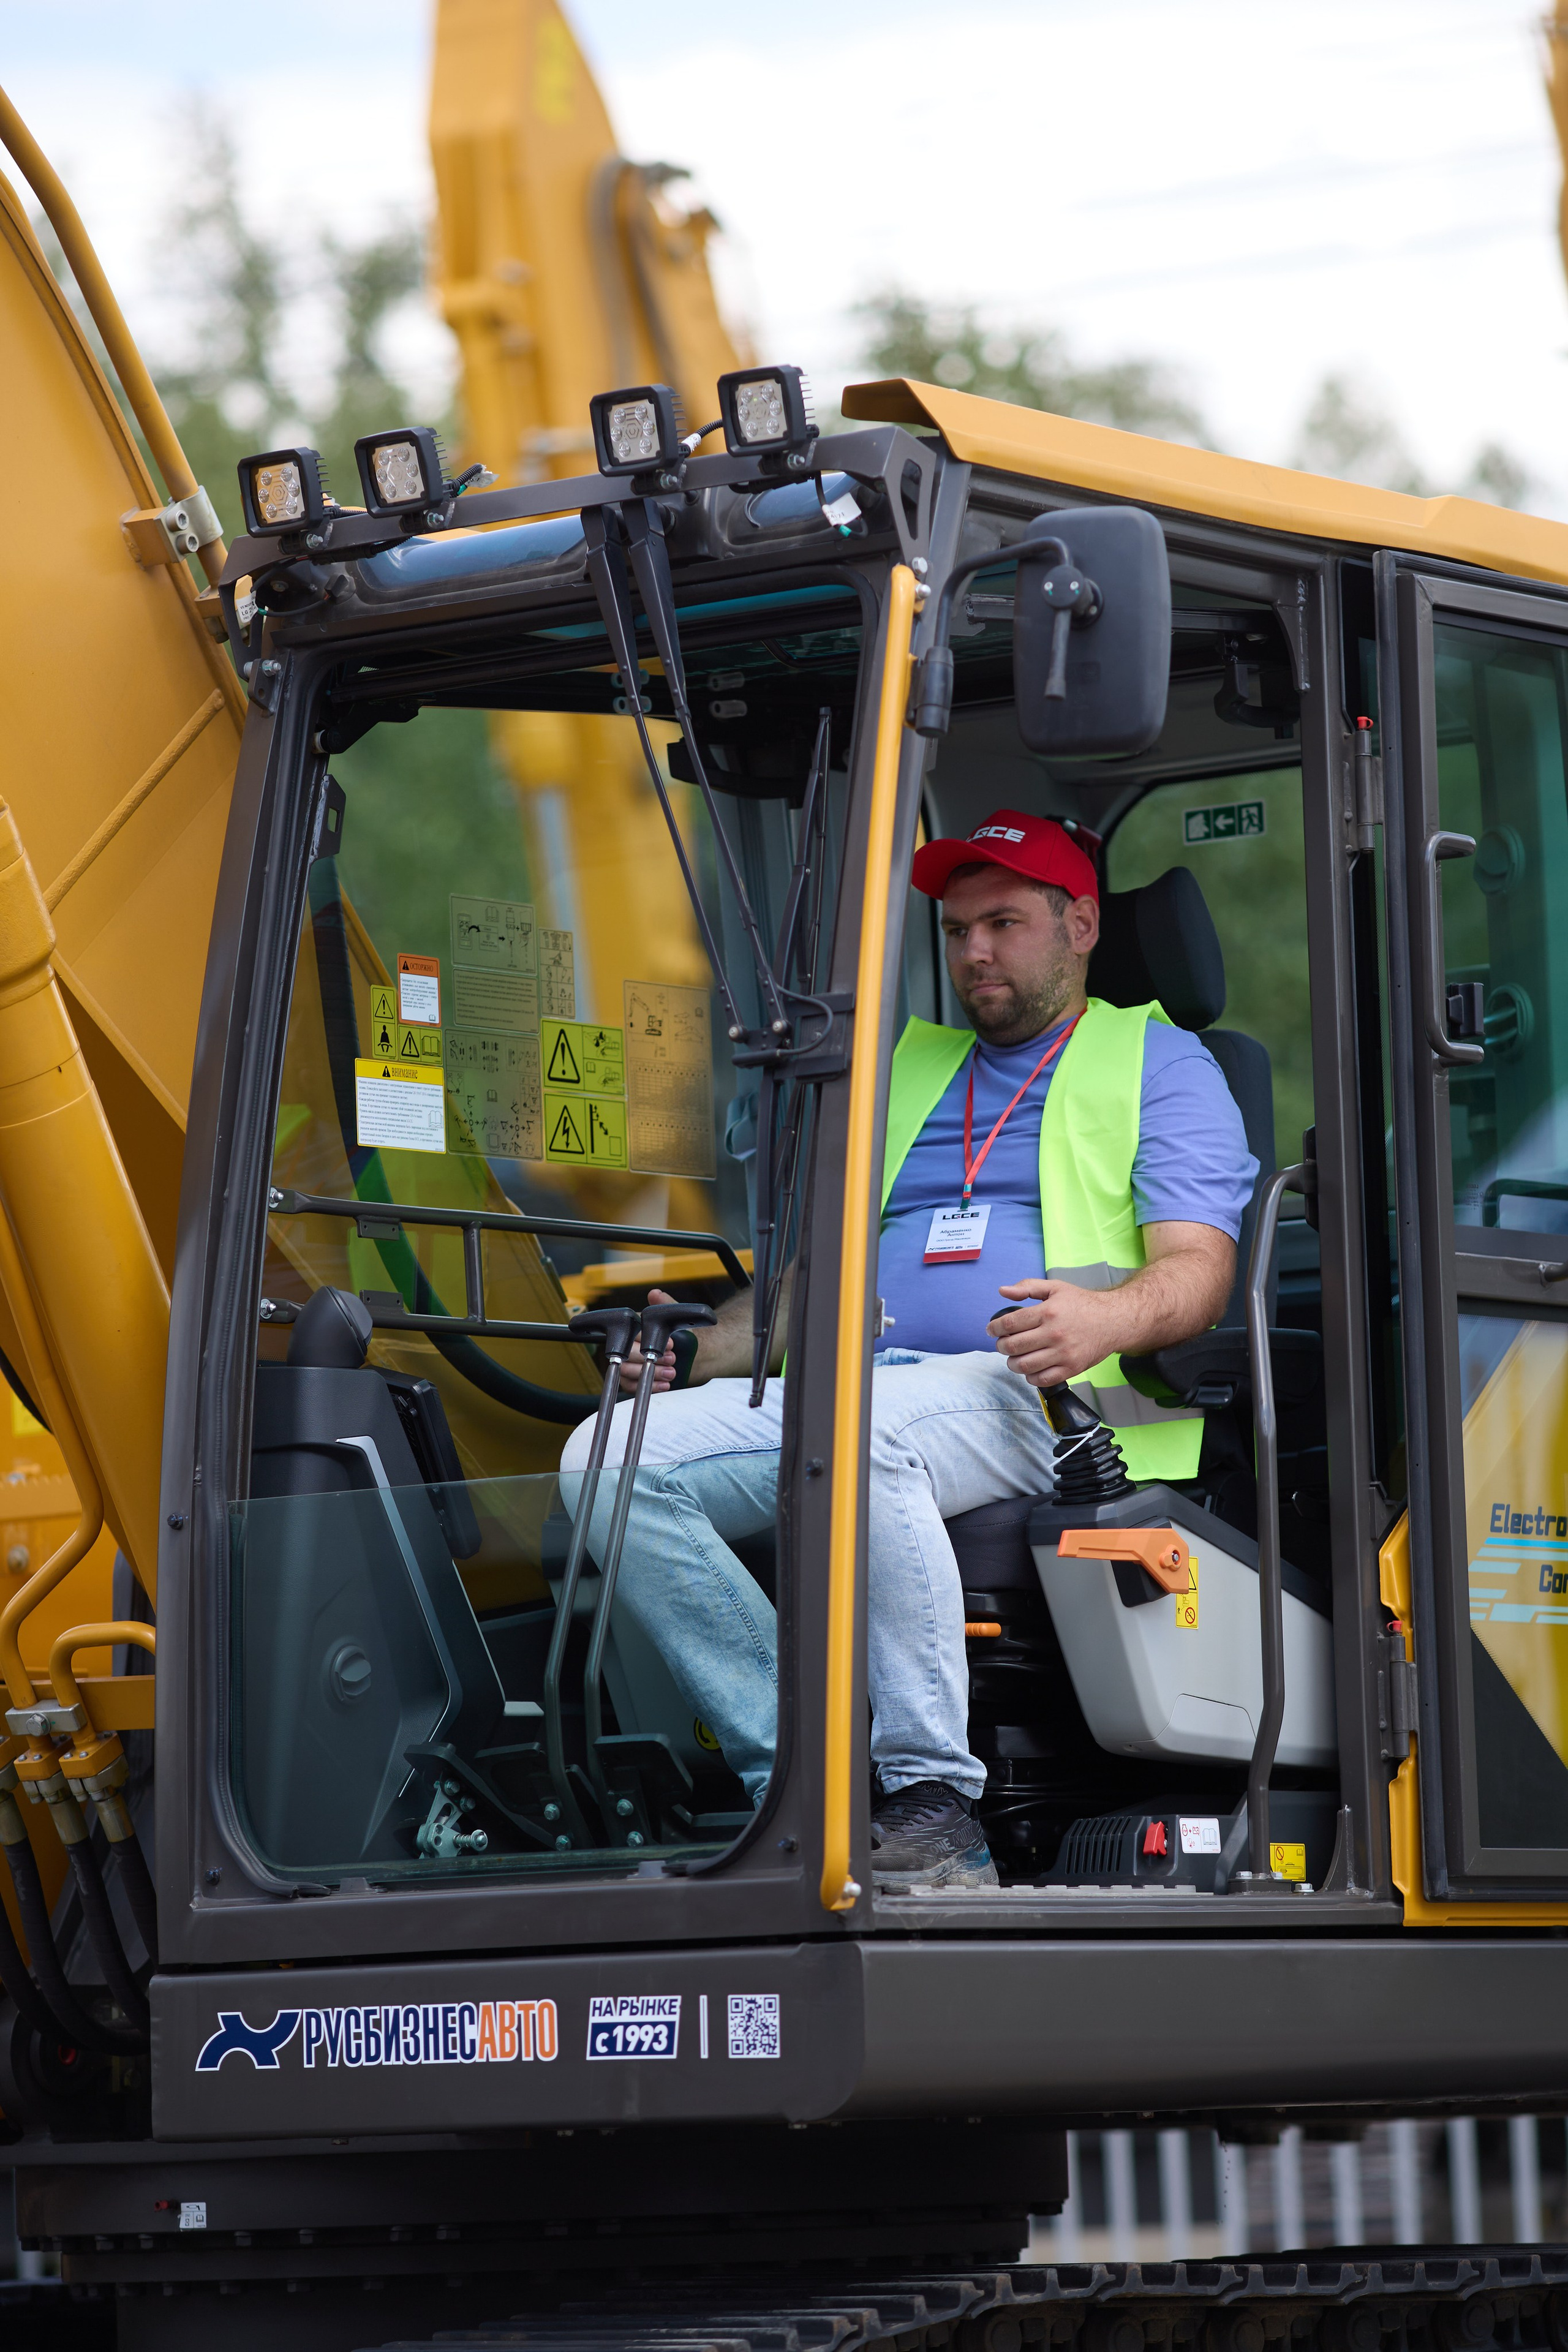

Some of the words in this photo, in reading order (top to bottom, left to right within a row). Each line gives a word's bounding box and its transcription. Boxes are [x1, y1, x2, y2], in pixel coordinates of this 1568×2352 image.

[1490, 1503, 1567, 1537] Electro
[592, 2000, 613, 2016] НА
[619, 1999, 678, 2016] РЫНКЕ
[304, 2000, 557, 2066] РУСБИЗНЕСАВТО
[613, 2024, 668, 2052] 1993
